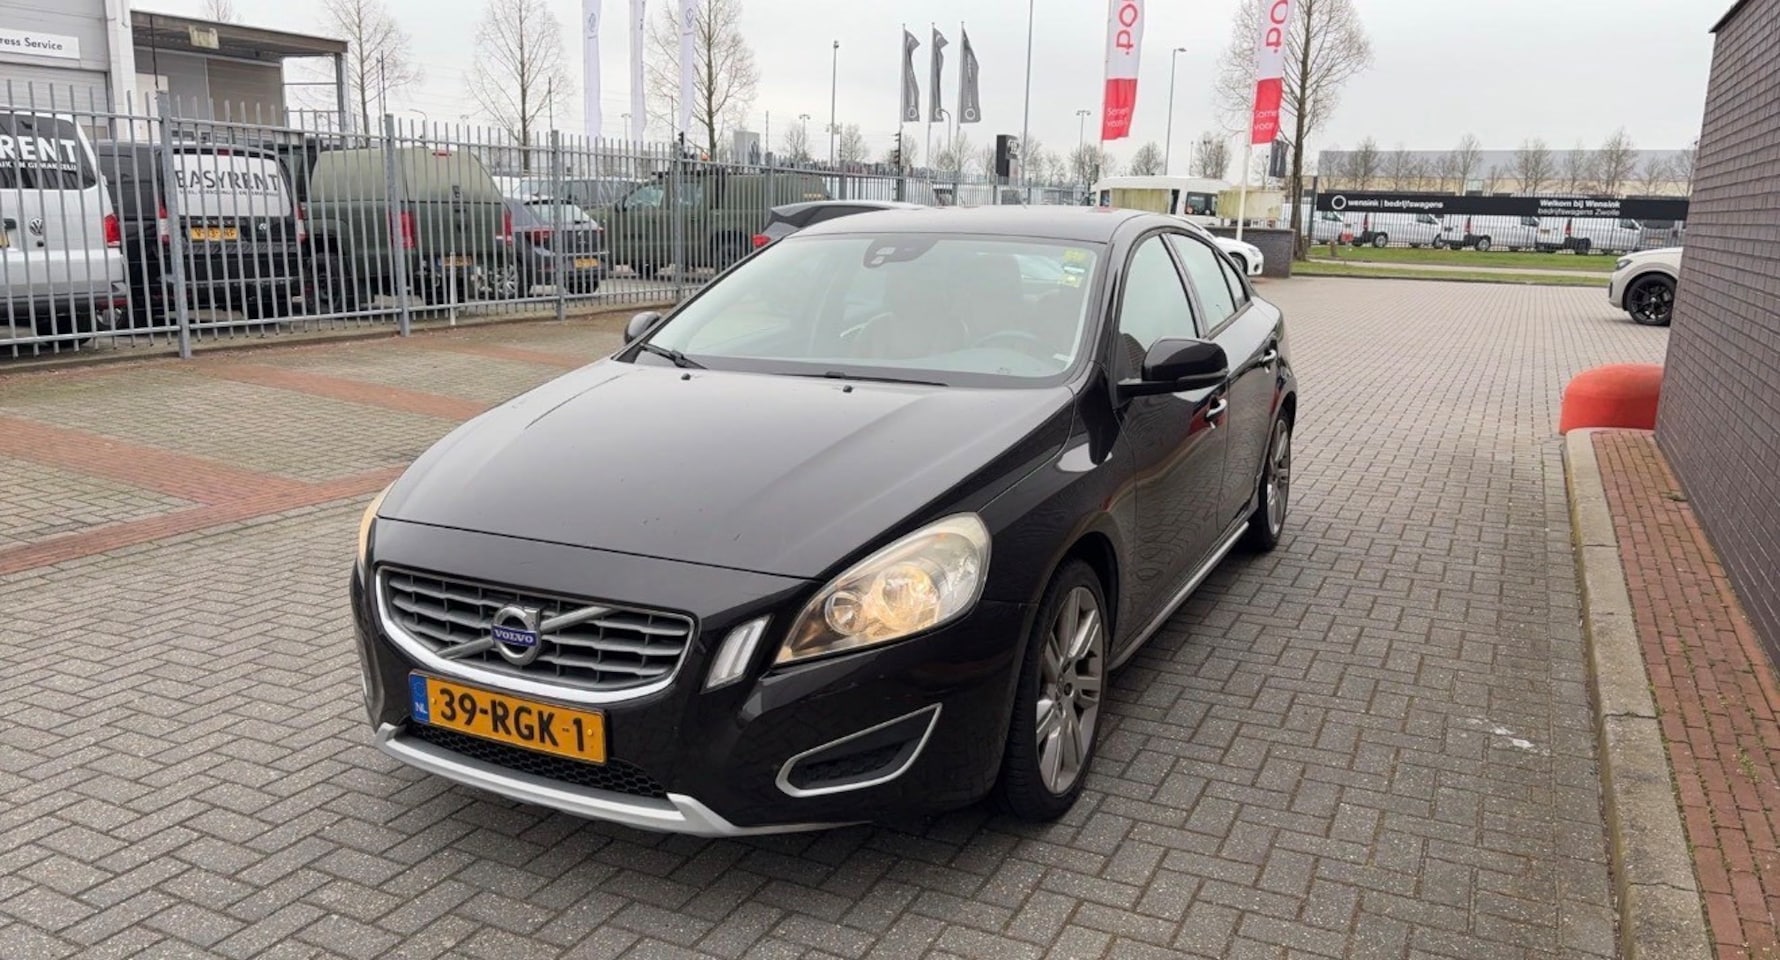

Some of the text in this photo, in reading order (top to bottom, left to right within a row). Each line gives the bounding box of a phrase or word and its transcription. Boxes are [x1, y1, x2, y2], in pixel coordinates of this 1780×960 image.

[24, 37, 63, 50] Service
[175, 170, 278, 191] EASYRENT
[1347, 198, 1444, 210] wensink bedrijfswagens
[1540, 199, 1620, 208] Welkom bij Wensink
[494, 629, 534, 643] VOLVO
[414, 687, 584, 752] NL 39-RGK-1
